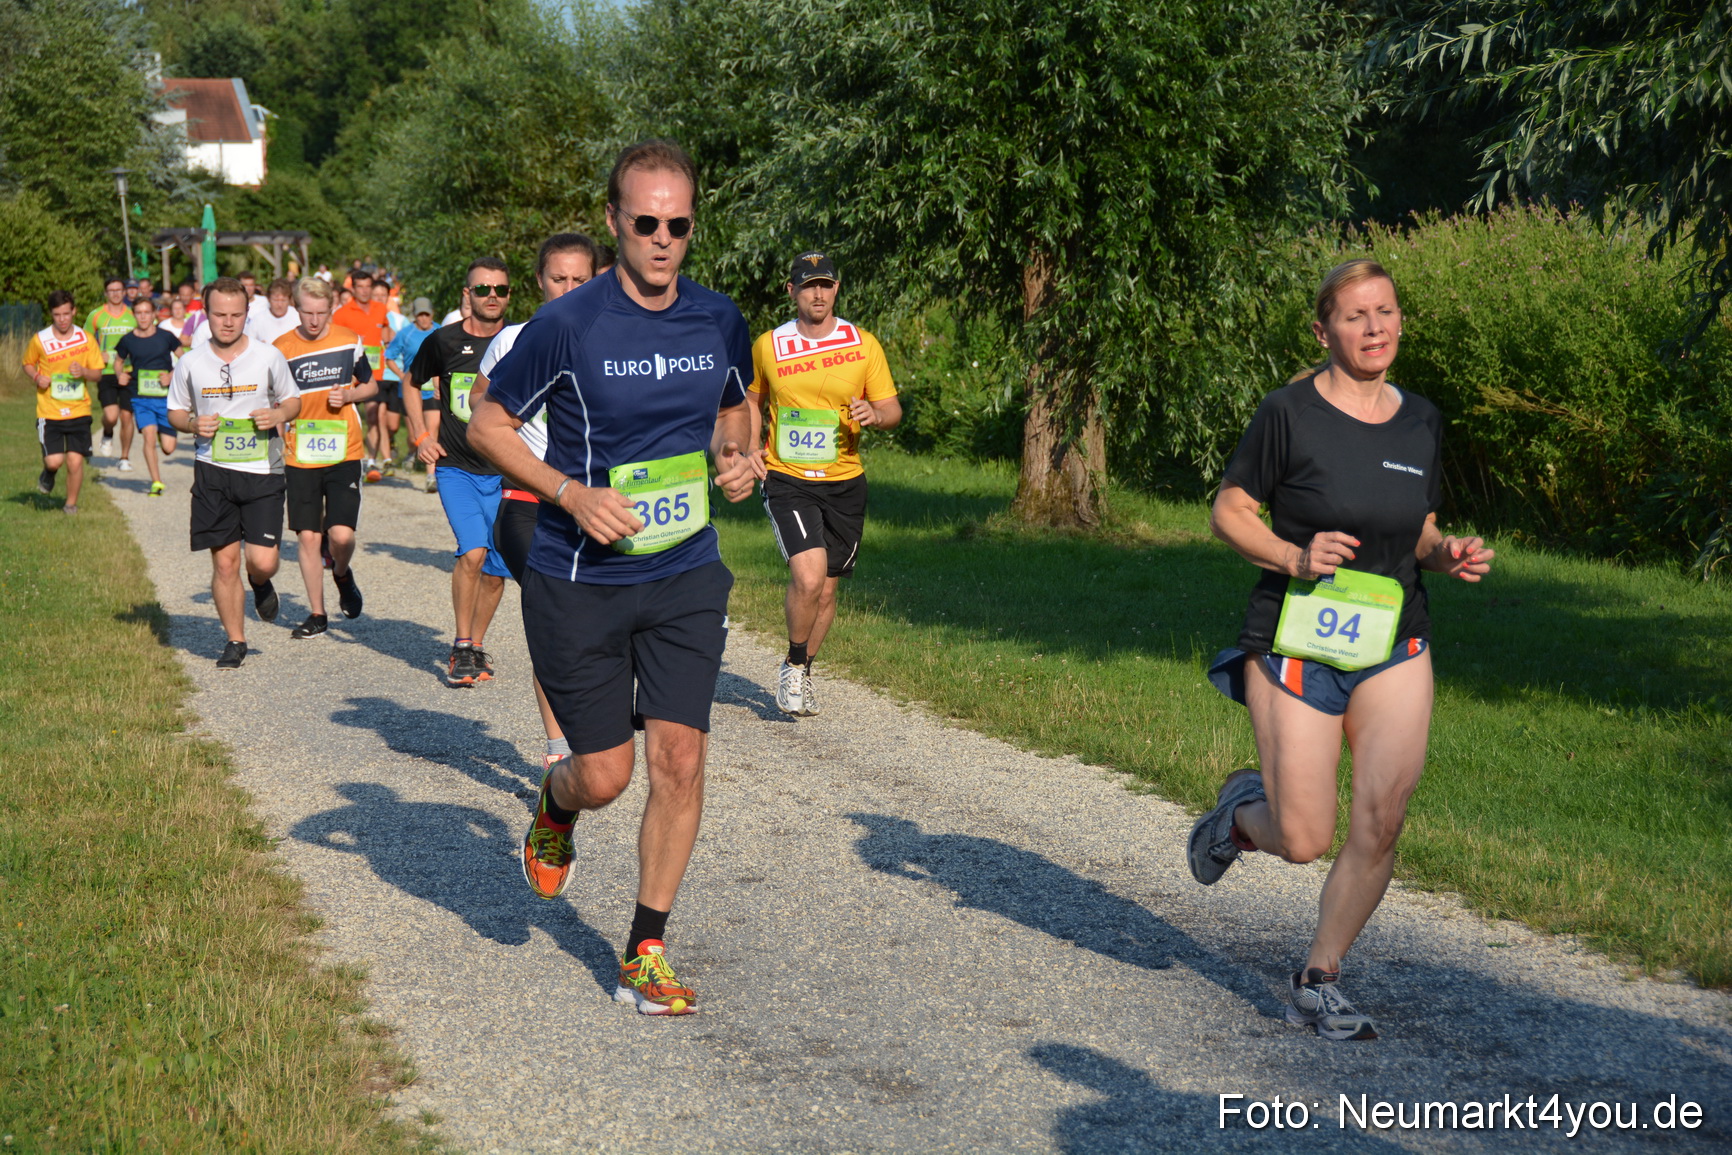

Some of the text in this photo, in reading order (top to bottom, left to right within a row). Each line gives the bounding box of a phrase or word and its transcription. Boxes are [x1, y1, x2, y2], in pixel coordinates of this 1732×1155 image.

[302, 366, 343, 379] Fischer
[604, 354, 714, 376] EURO POLES
[777, 351, 866, 378] MAX BÖGL
[224, 436, 257, 450] 534
[306, 438, 337, 451] 464
[788, 430, 826, 449] 942
[1382, 461, 1423, 476] Christine Wenzl
[632, 492, 690, 529] 365
[633, 533, 660, 543] Christian
[660, 527, 692, 538] Gütermann
[1315, 607, 1361, 643] 94
[1306, 642, 1337, 654] Christine
[1338, 649, 1359, 658] Wenzl
